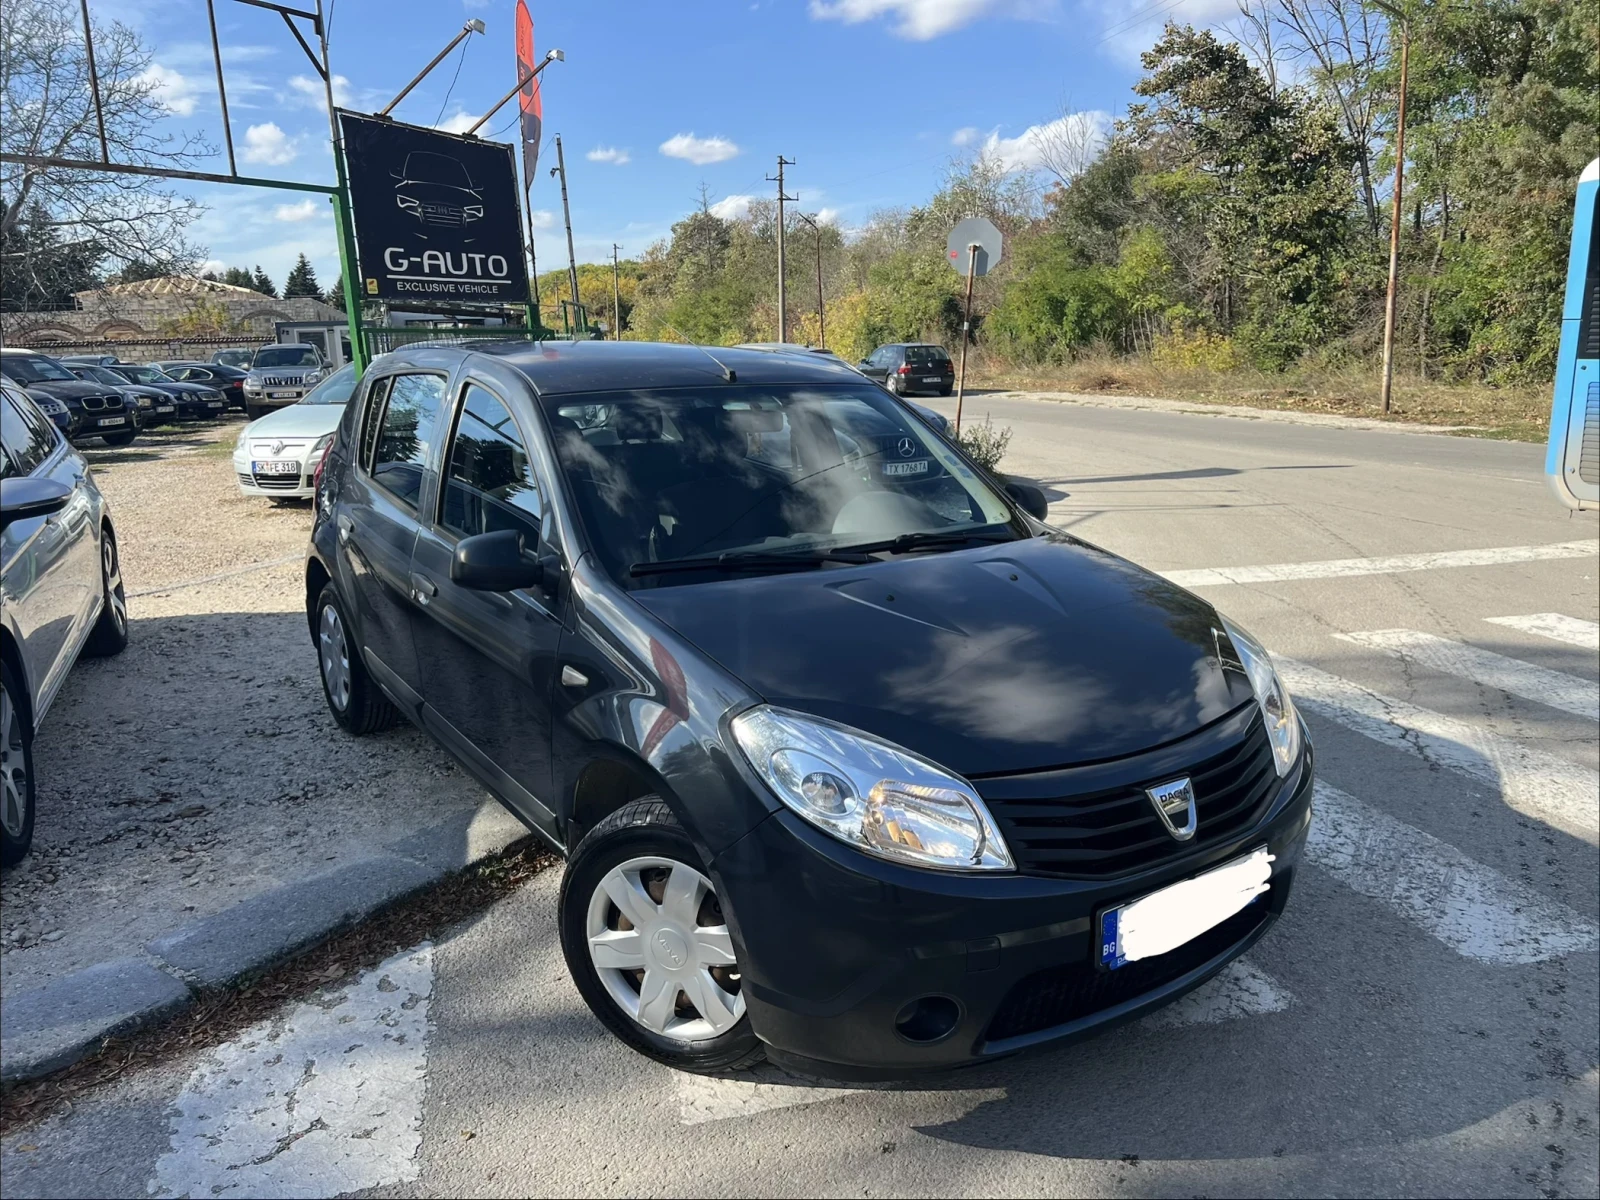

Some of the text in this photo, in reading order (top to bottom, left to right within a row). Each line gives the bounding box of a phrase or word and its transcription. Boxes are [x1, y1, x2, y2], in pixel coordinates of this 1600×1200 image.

[384, 247, 508, 277] G-AUTO
[397, 281, 499, 294] EXCLUSIVE VEHICLE
[281, 462, 295, 472] 318
[888, 462, 927, 474] TX 1768 TA
[1159, 787, 1190, 803] DACIA
[1103, 941, 1116, 957] BG
